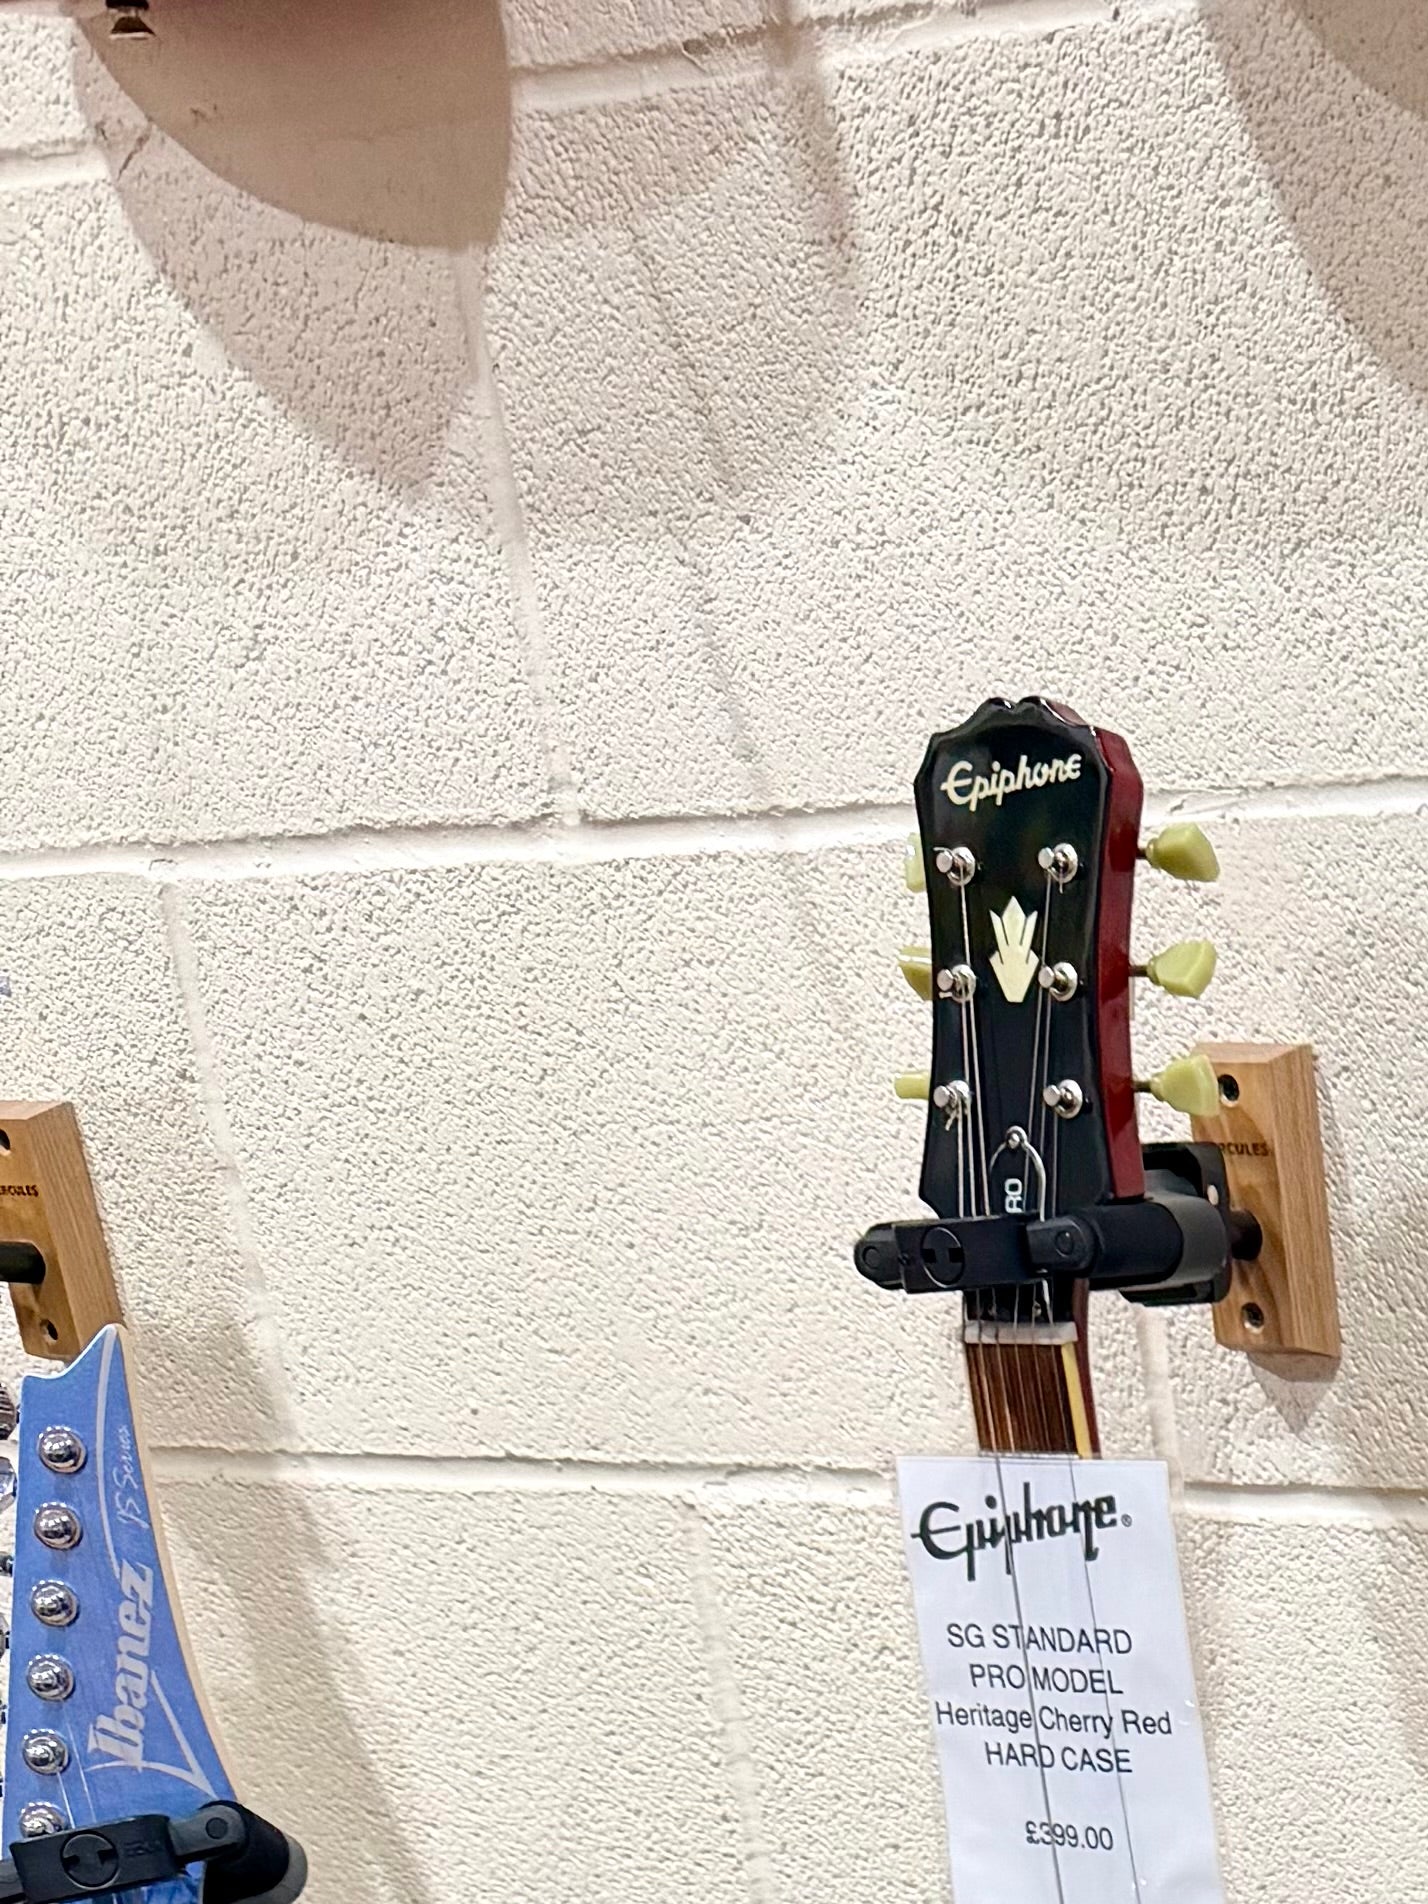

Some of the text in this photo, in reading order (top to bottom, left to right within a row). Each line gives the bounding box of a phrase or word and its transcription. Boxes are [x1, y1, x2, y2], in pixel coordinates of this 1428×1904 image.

[940, 753, 1082, 812] Epiphone
[1219, 1141, 1270, 1157] CULES
[911, 1481, 1118, 1582] Epiphone
[946, 1623, 1133, 1656] SG STANDARD
[87, 1557, 154, 1773] Ibanez
[969, 1664, 1124, 1696] PRO MODEL
[935, 1701, 1173, 1740] Heritage Cherry Red
[984, 1742, 1133, 1774] HARD CASE
[1025, 1820, 1114, 1851] £399.00
